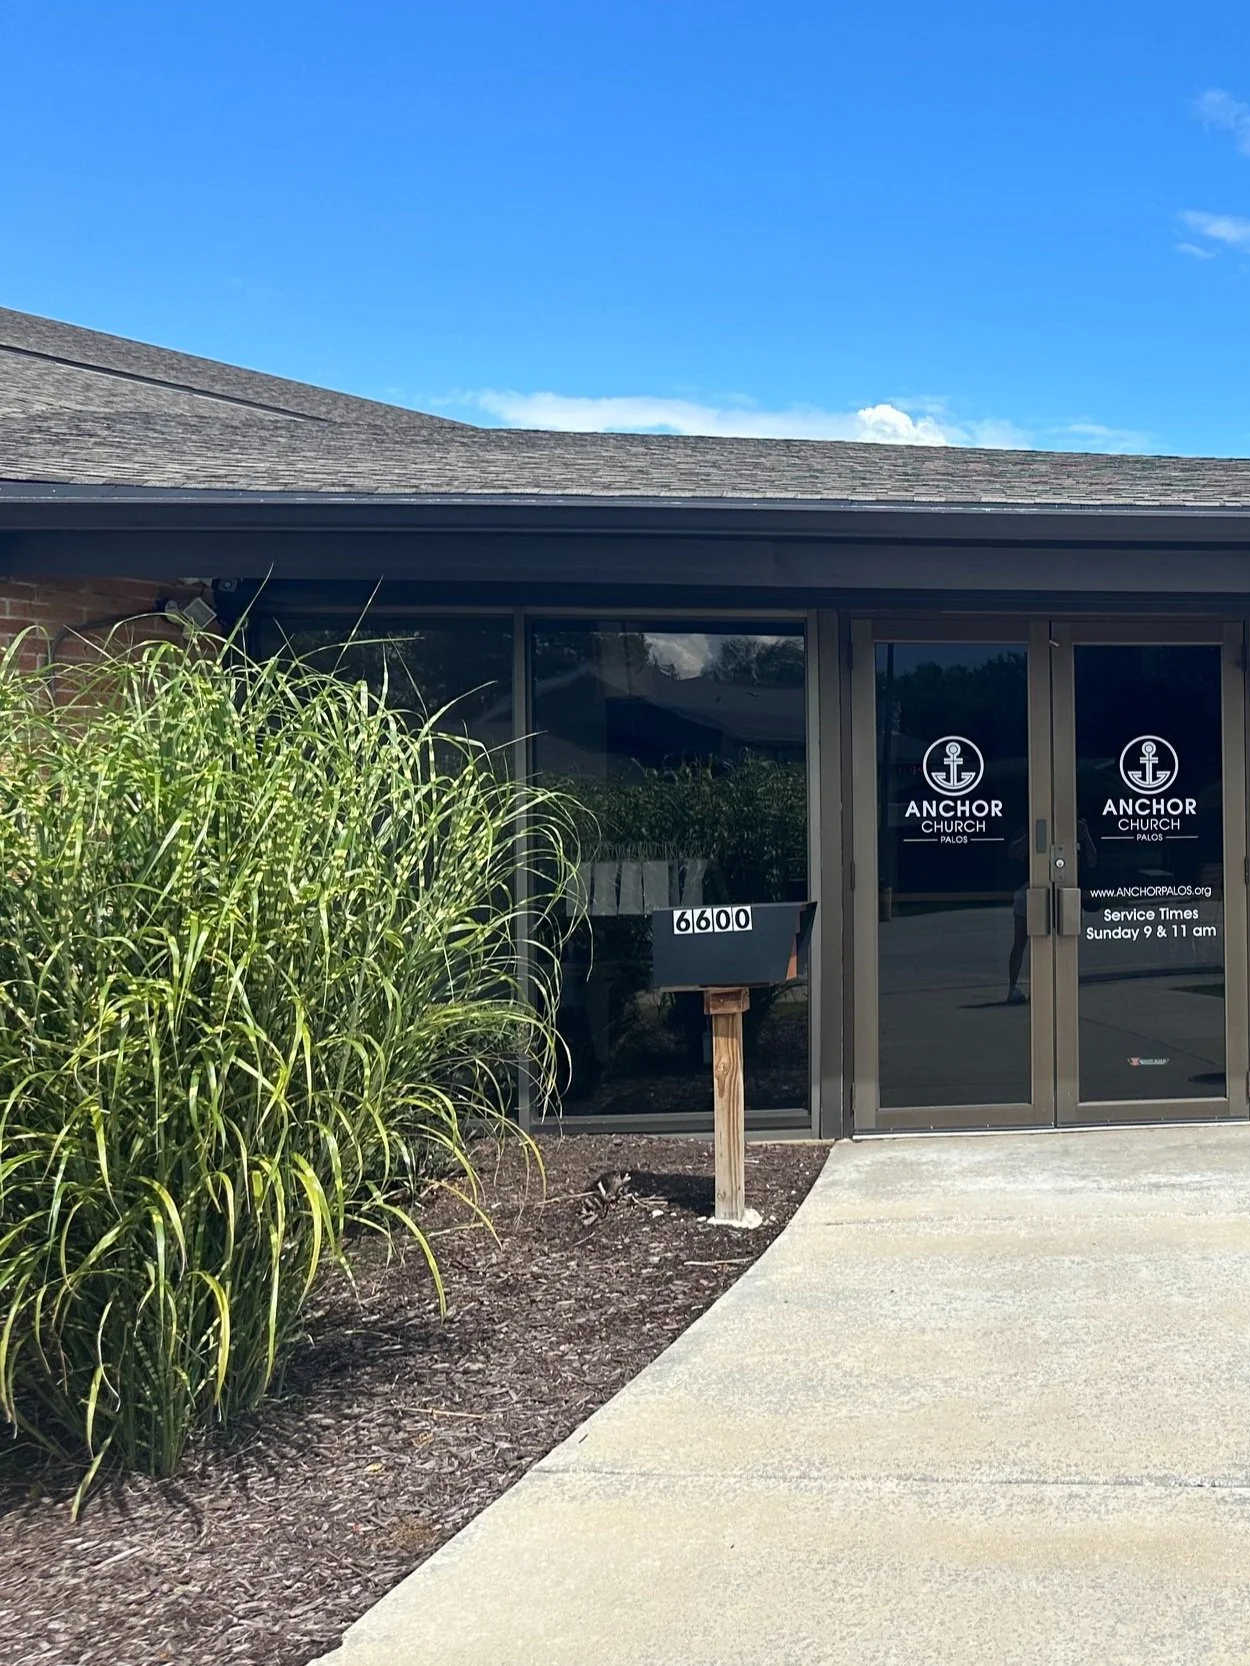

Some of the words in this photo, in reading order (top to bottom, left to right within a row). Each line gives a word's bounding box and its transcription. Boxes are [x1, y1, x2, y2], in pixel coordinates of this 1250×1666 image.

[904, 799, 1003, 818] ANCHOR
[1102, 798, 1197, 816] ANCHOR
[921, 819, 986, 834] CHURCH
[1117, 818, 1180, 831] CHURCH
[940, 835, 968, 844] PALOS
[1136, 833, 1163, 842] PALOS
[1089, 885, 1212, 898] www.ANCHORPALOS.org
[675, 908, 750, 932] 6600
[1103, 907, 1156, 922] Service
[1158, 907, 1199, 921] Times
[1086, 925, 1140, 942] Sunday
[1143, 925, 1153, 939] 9
[1156, 924, 1168, 938] &
[1171, 924, 1187, 938] 11
[1192, 925, 1217, 937] am
